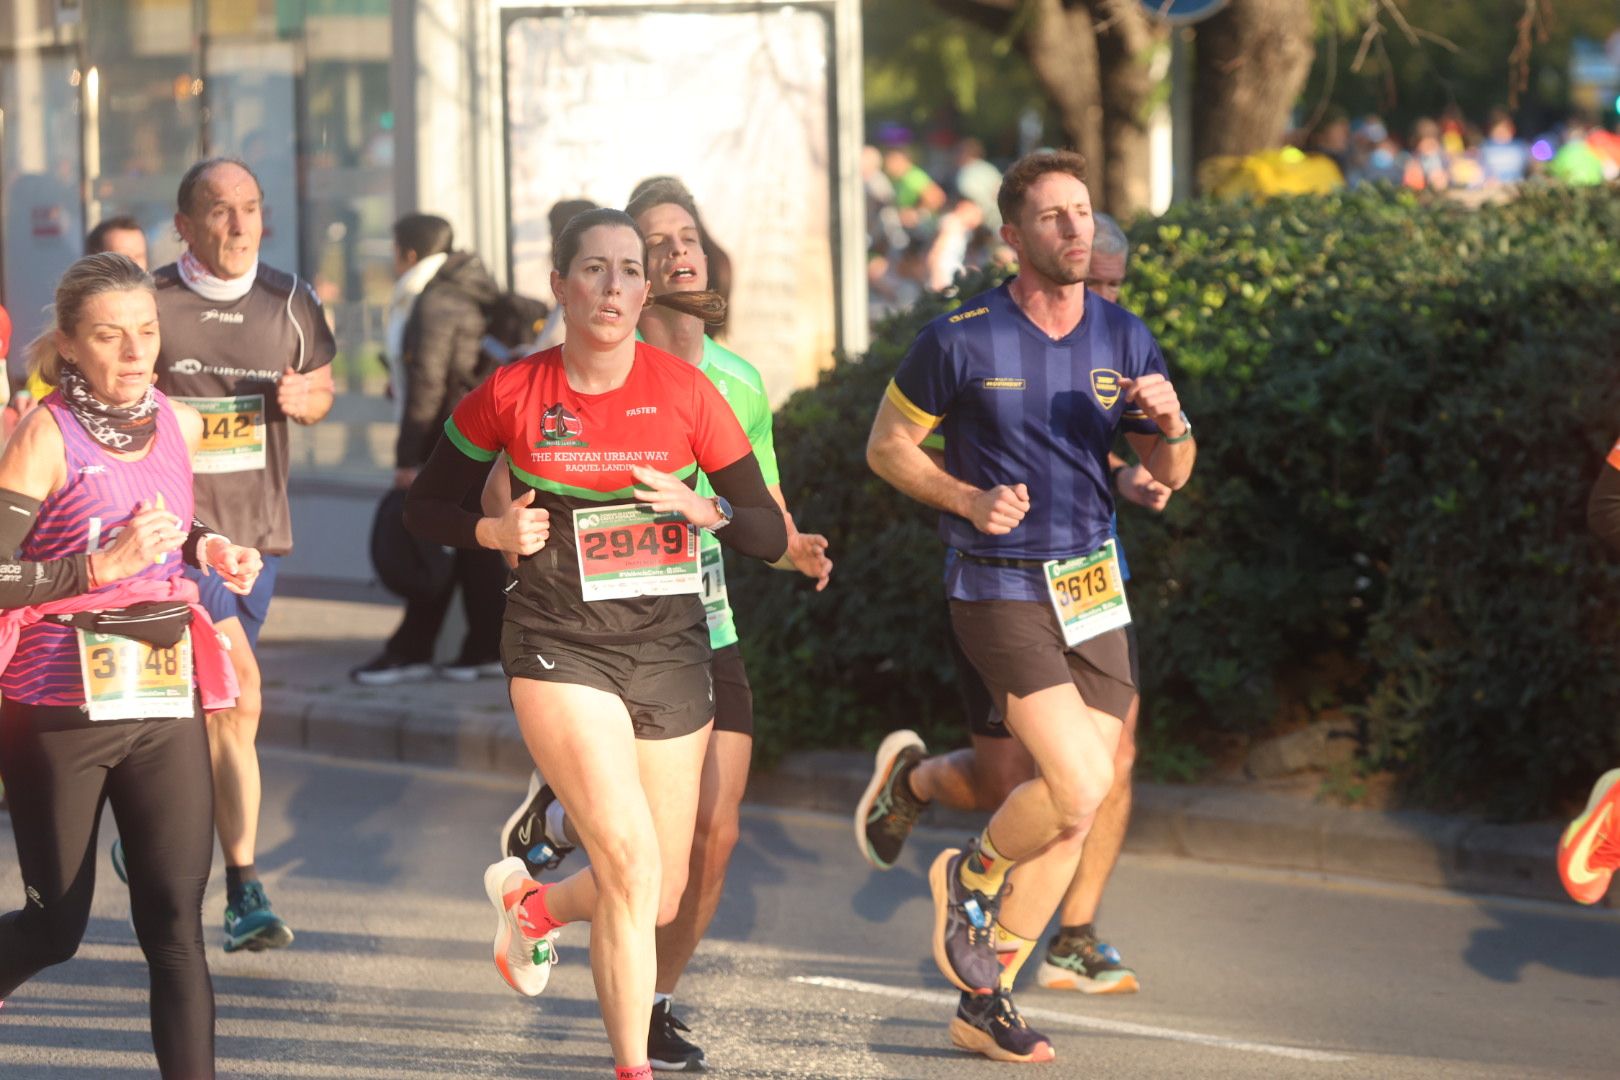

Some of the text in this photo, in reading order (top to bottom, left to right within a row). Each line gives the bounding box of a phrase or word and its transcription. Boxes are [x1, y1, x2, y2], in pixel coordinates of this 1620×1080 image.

[626, 406, 657, 417] FASTER
[530, 451, 669, 462] THE KENYAN URBAN WAY
[565, 464, 600, 472] RAQUEL
[584, 524, 683, 561] 2949
[1055, 566, 1107, 607] 3613
[92, 646, 177, 679] 348
